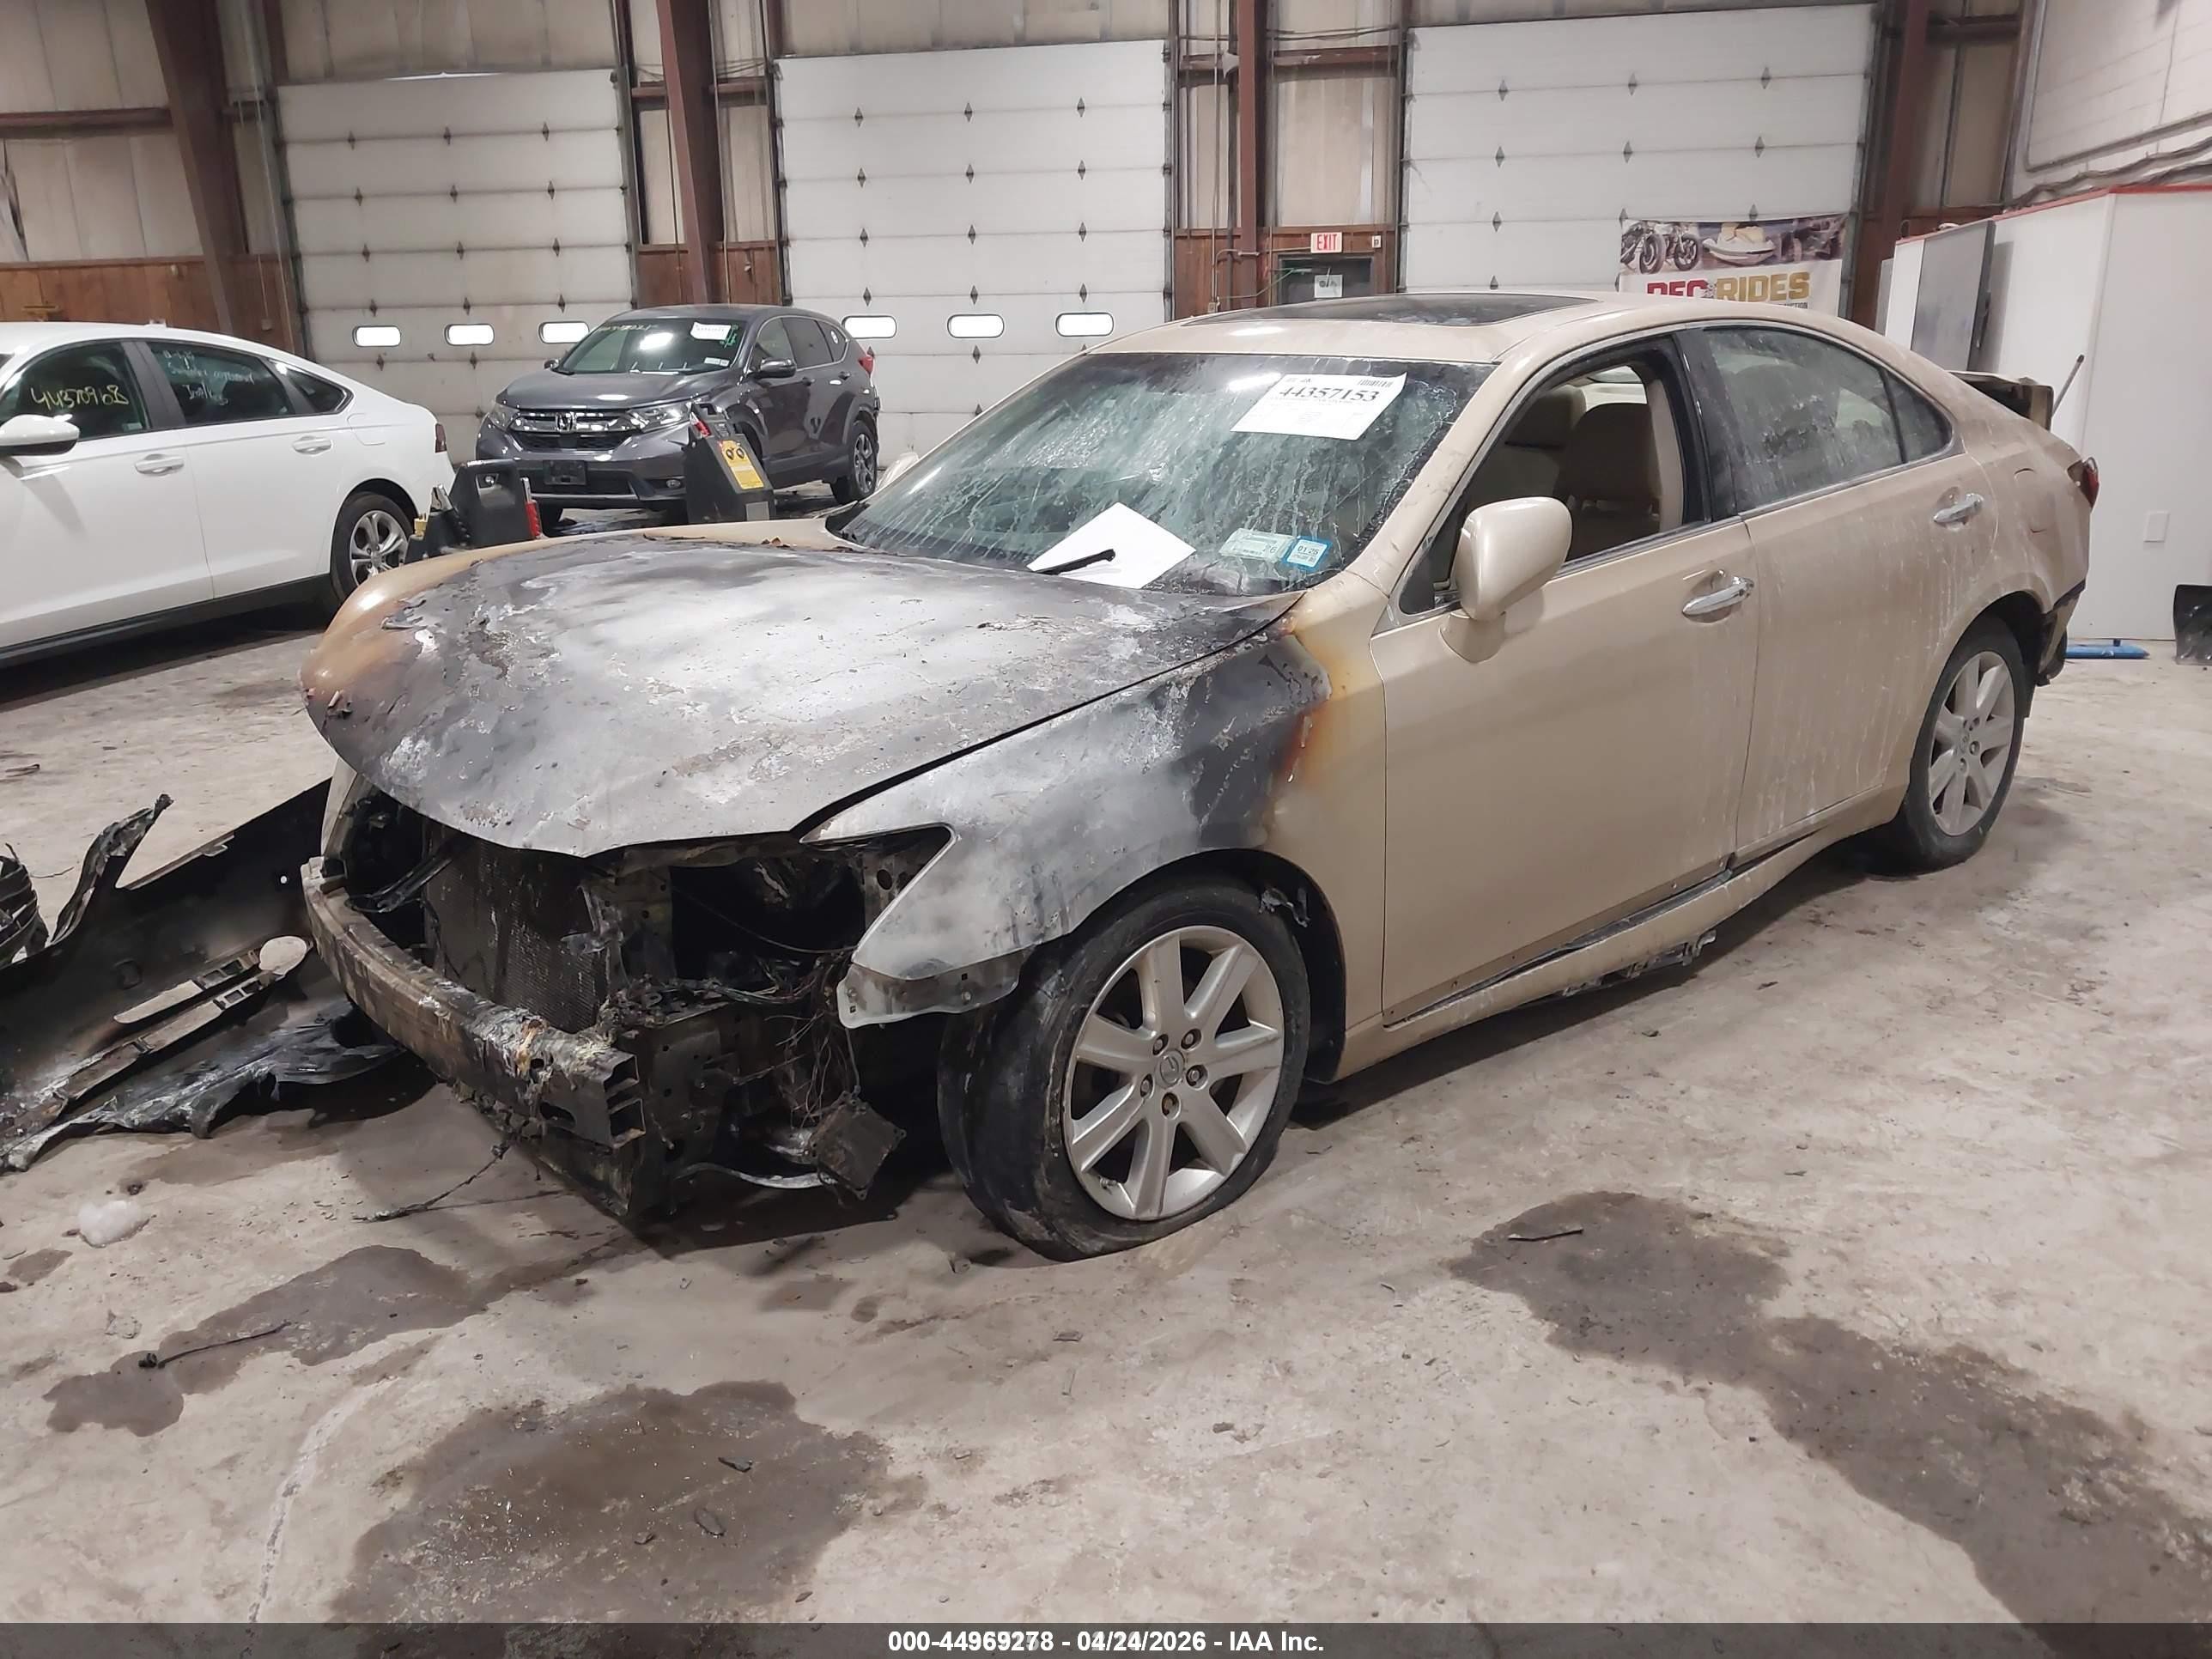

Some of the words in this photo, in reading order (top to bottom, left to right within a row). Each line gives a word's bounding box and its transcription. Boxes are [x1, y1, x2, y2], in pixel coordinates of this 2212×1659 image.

[1317, 234, 1337, 251] EXIT
[1717, 271, 1811, 302] RIDES
[1279, 386, 1380, 403] 44357153
